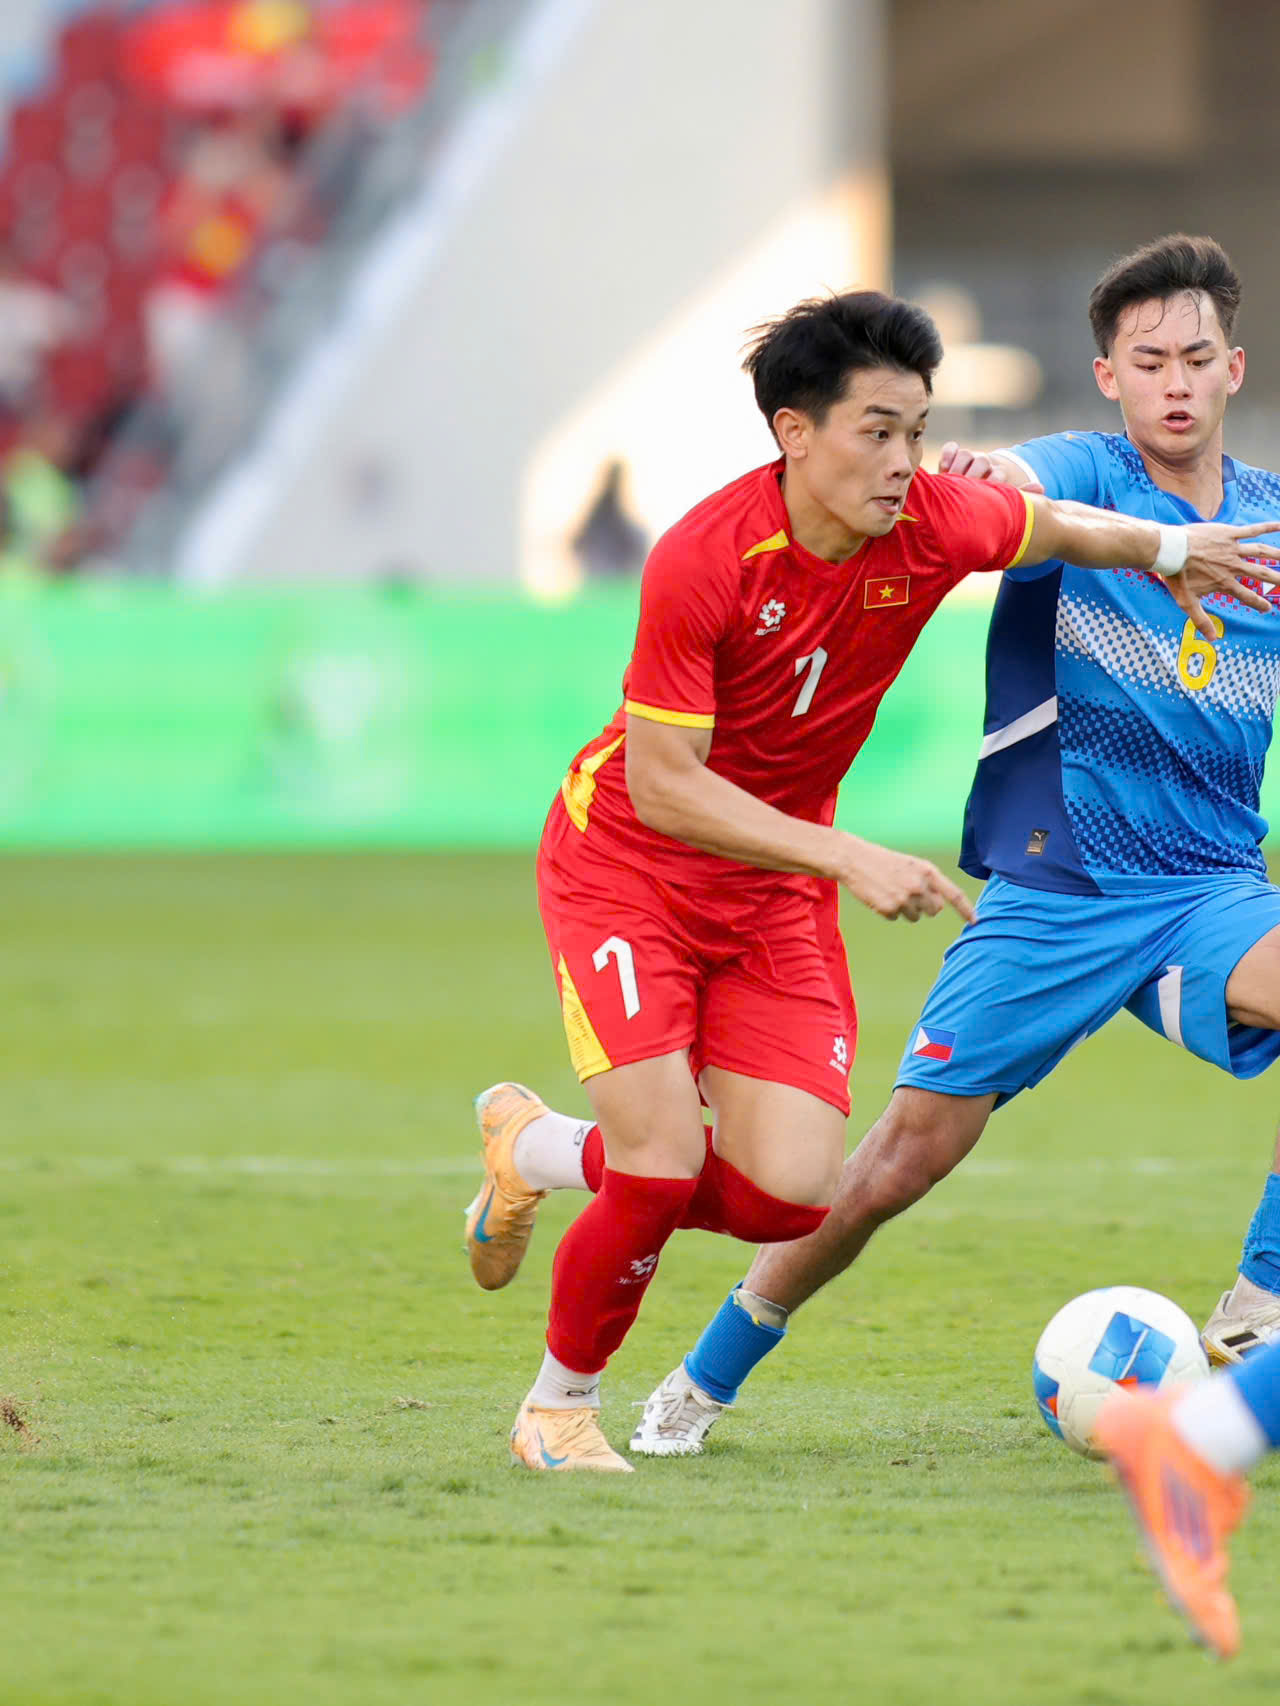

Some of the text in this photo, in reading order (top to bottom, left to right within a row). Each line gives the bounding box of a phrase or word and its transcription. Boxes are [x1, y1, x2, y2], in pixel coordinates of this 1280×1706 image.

[791, 646, 828, 718] 7
[1177, 613, 1224, 691] 6
[592, 936, 641, 1021] 7
